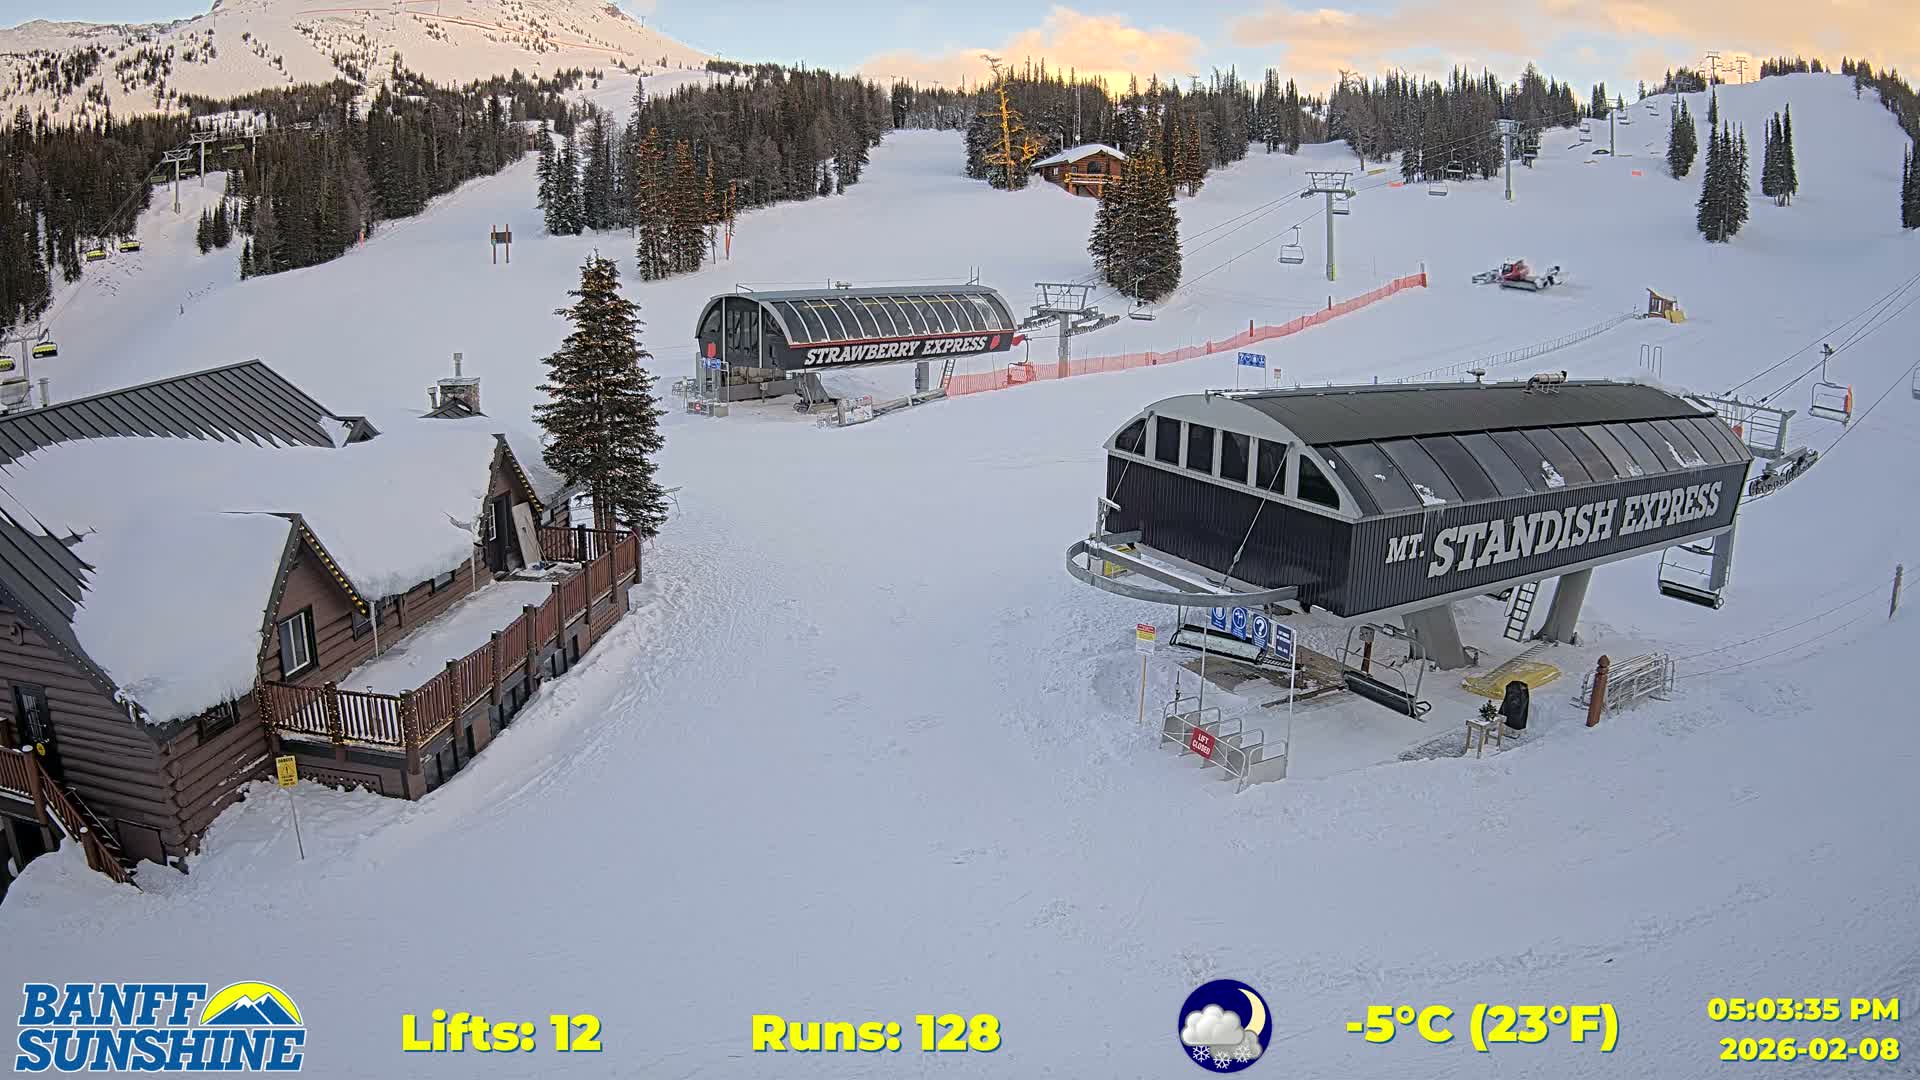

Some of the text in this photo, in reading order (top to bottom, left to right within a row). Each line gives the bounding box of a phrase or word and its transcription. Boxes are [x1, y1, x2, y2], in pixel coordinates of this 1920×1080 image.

[804, 336, 988, 366] STRAWBERRY EXPRESS
[1385, 481, 1722, 578] MT. STANDISH EXPRESS
[1192, 739, 1211, 755] CLOSED
[1198, 734, 1209, 745] LIFT
